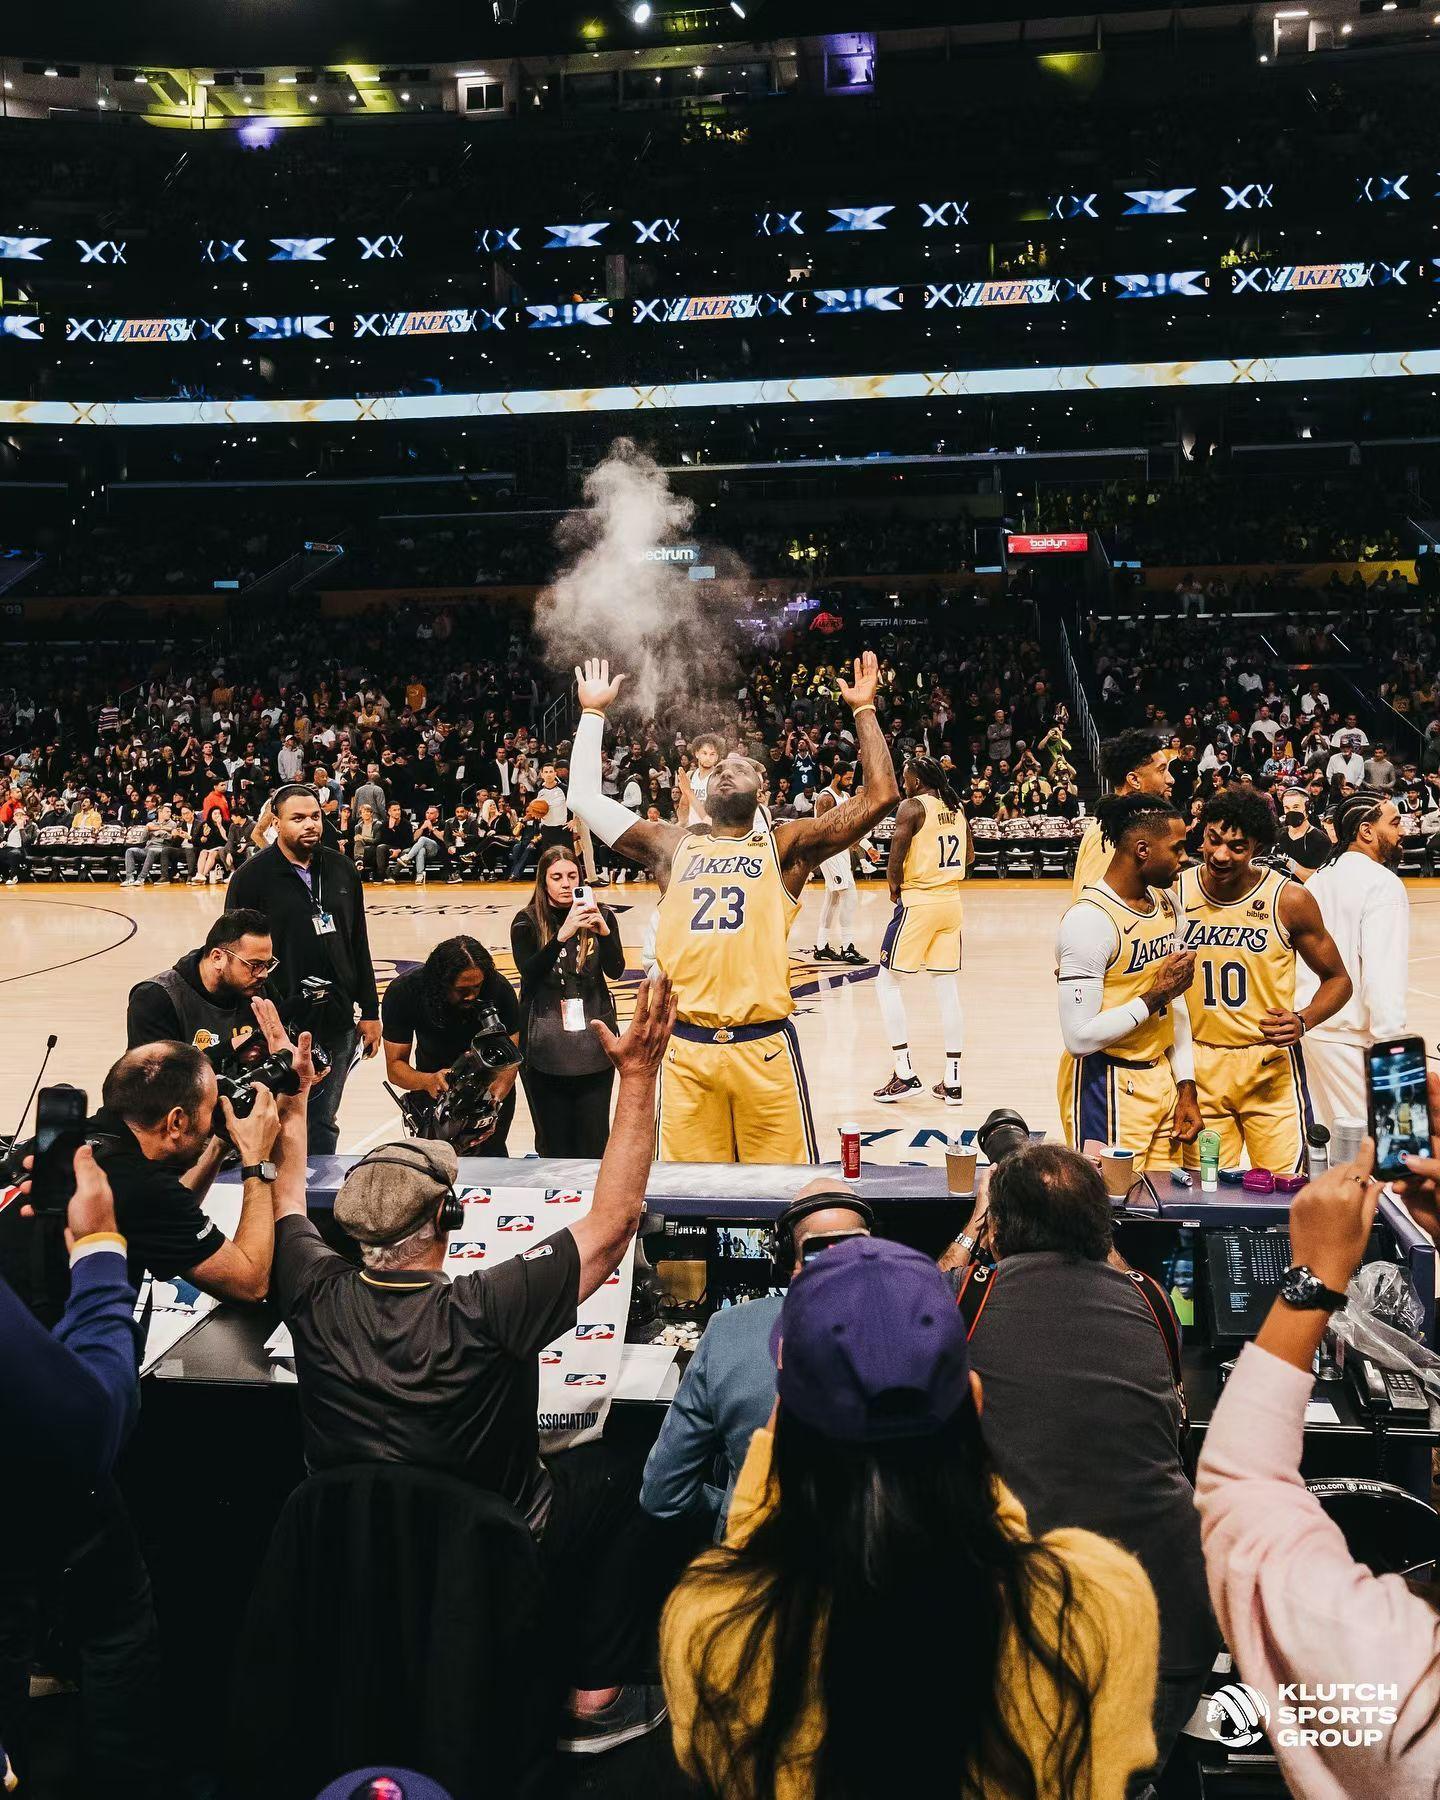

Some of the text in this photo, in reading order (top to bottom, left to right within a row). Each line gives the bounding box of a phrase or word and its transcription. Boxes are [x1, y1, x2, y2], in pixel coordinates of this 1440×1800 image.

[646, 547, 694, 561] ectrum
[938, 812, 956, 826] PRINCE
[938, 835, 961, 868] 12
[678, 853, 763, 883] LAKERS
[690, 886, 745, 931] 23
[1246, 910, 1269, 920] bibigo
[1185, 920, 1269, 952] LAKERS
[1202, 961, 1247, 1007] 10
[1358, 1484, 1383, 1492] ARENA
